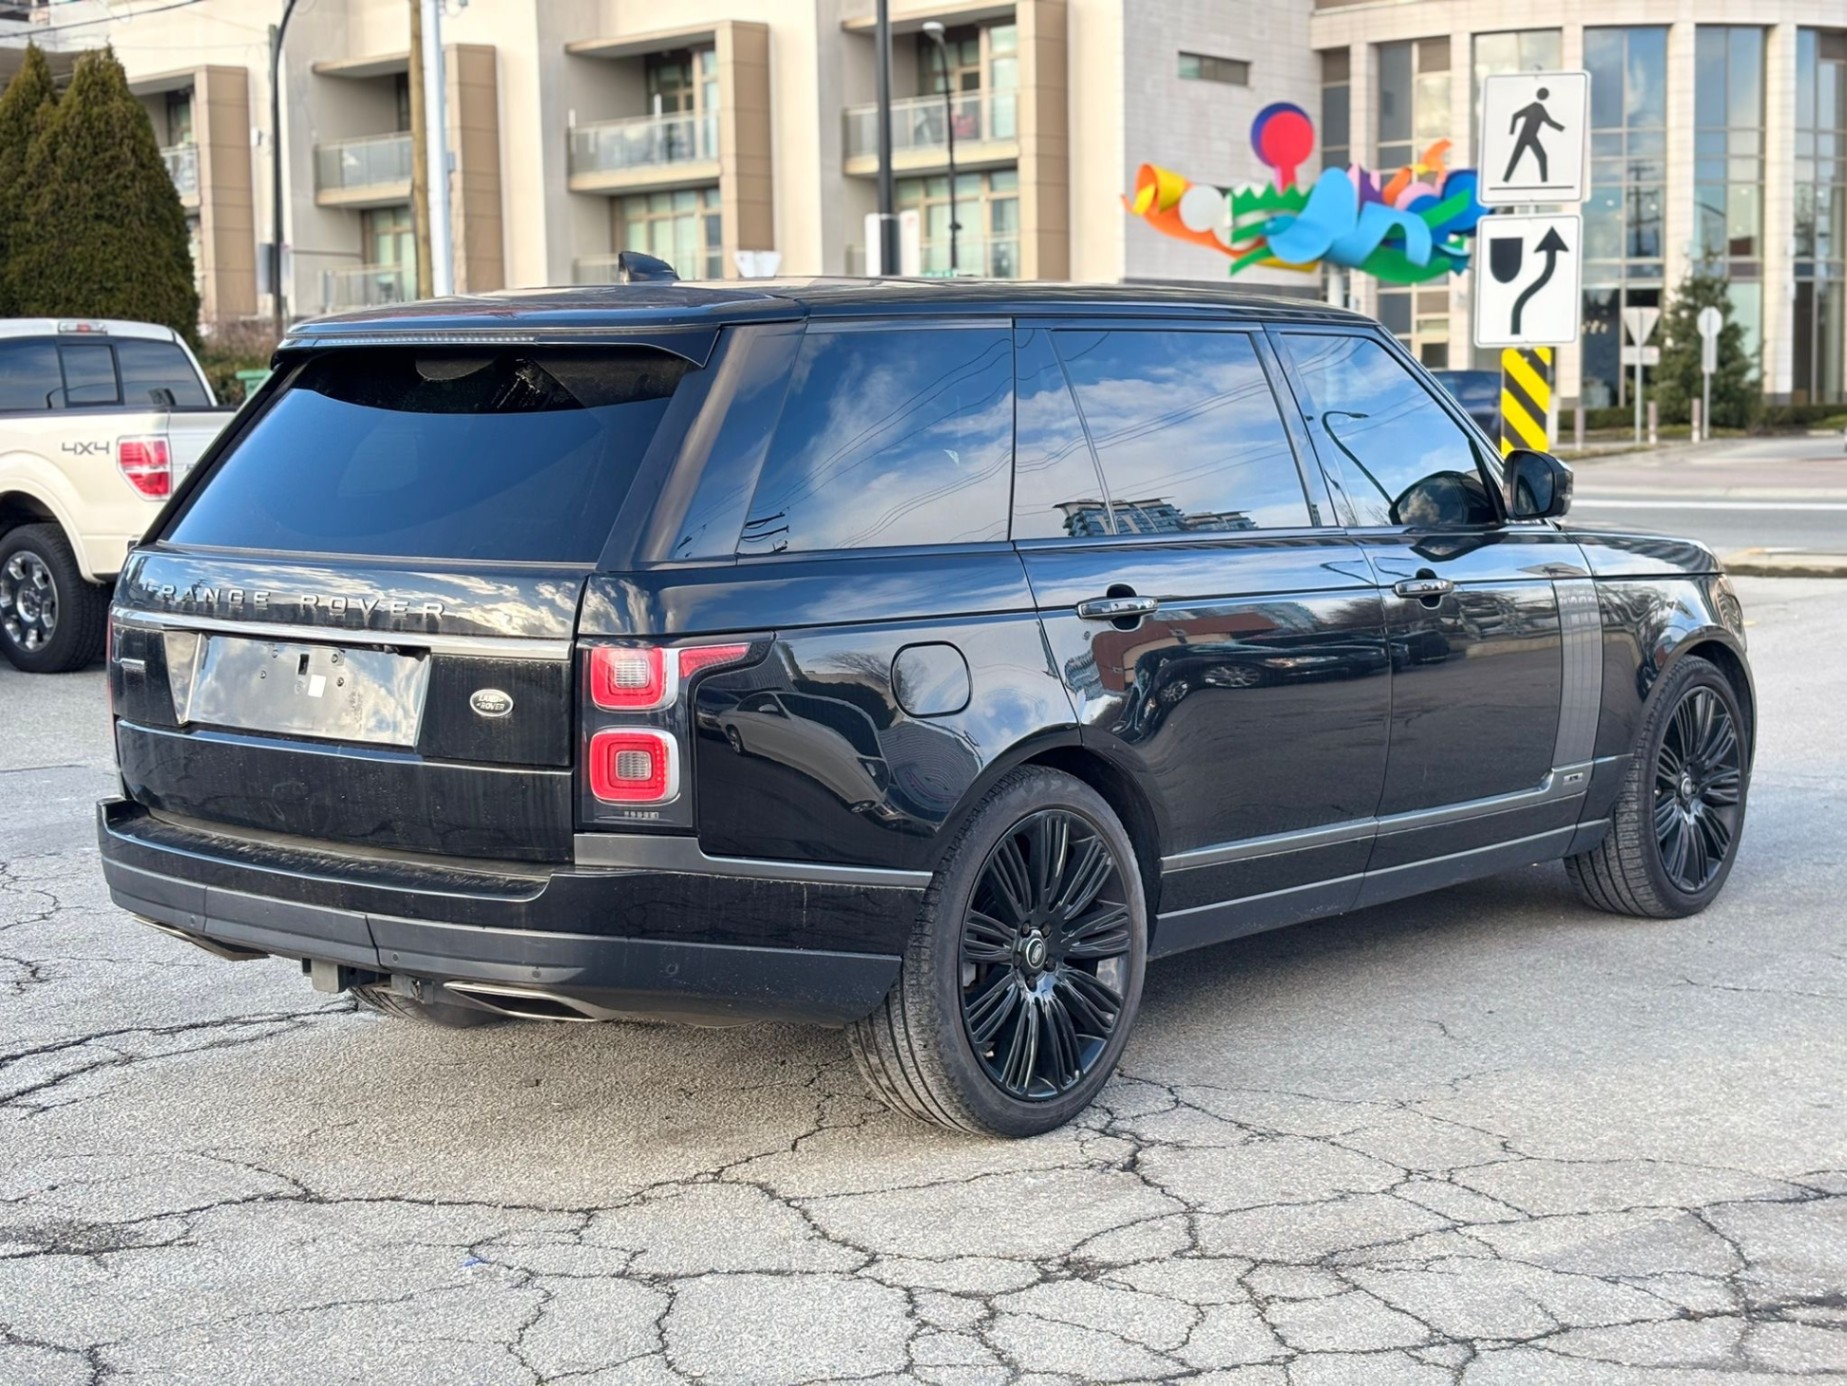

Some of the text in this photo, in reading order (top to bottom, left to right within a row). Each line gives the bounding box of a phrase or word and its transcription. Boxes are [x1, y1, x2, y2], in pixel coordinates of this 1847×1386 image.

[61, 441, 110, 455] 4X4
[160, 584, 445, 621] RANGE ROVER
[480, 702, 505, 711] ROVER
